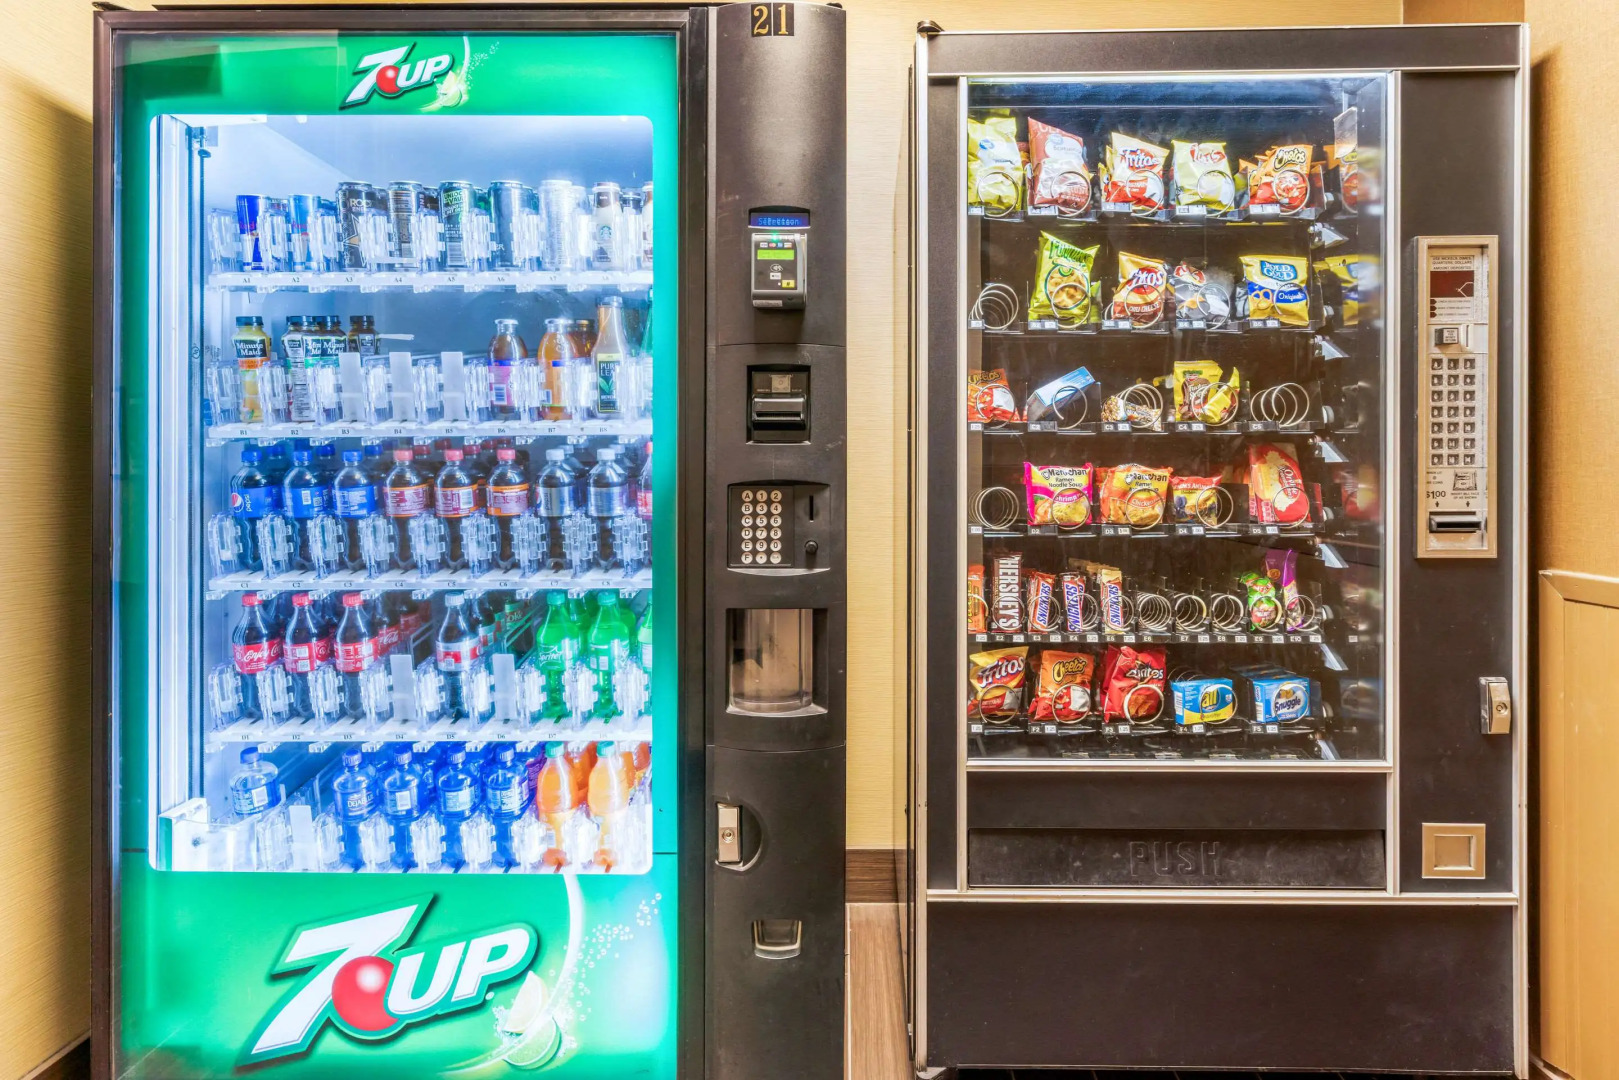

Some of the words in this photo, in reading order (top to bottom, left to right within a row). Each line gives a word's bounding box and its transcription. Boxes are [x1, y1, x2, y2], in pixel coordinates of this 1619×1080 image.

[753, 4, 789, 35] 21
[240, 348, 261, 356] Maid
[1055, 493, 1077, 502] Shrimp
[1037, 583, 1052, 625] SNICKERS
[1065, 584, 1081, 632] SNICKERS
[1108, 584, 1121, 625] SNICKERS
[539, 652, 562, 662] Sprite
[977, 657, 1025, 688] Fritos
[1202, 689, 1217, 707] all
[1275, 696, 1301, 712] Snuggle
[1129, 841, 1222, 876] PUSH
